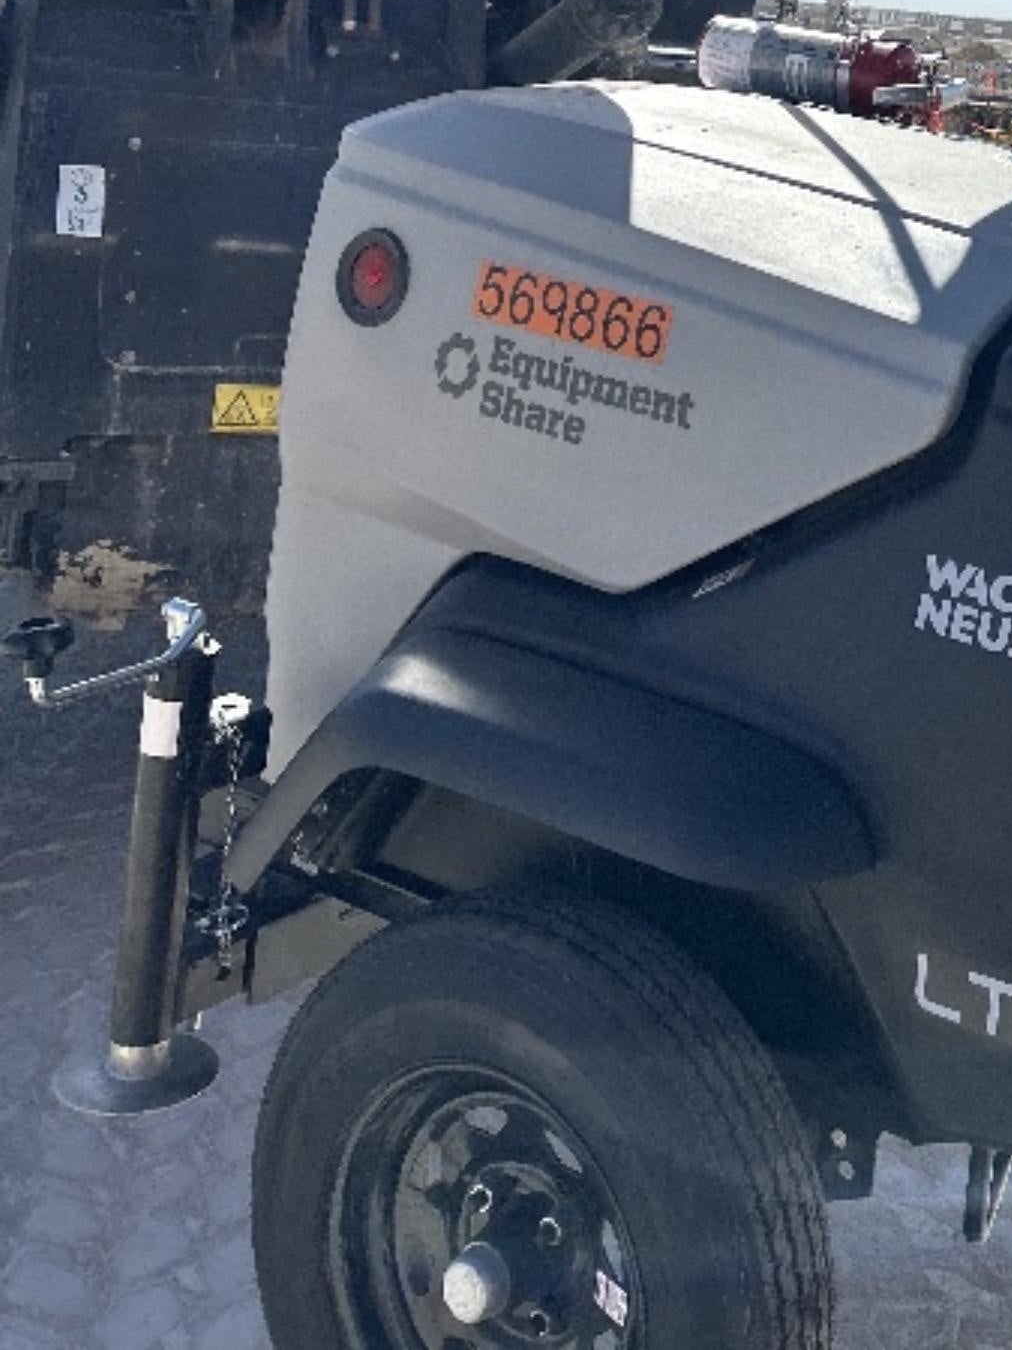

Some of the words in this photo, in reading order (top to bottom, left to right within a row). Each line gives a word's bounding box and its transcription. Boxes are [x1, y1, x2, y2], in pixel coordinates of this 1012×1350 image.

[478, 265, 667, 357] 569866
[479, 380, 586, 445] Share
[488, 334, 695, 430] Equipment
